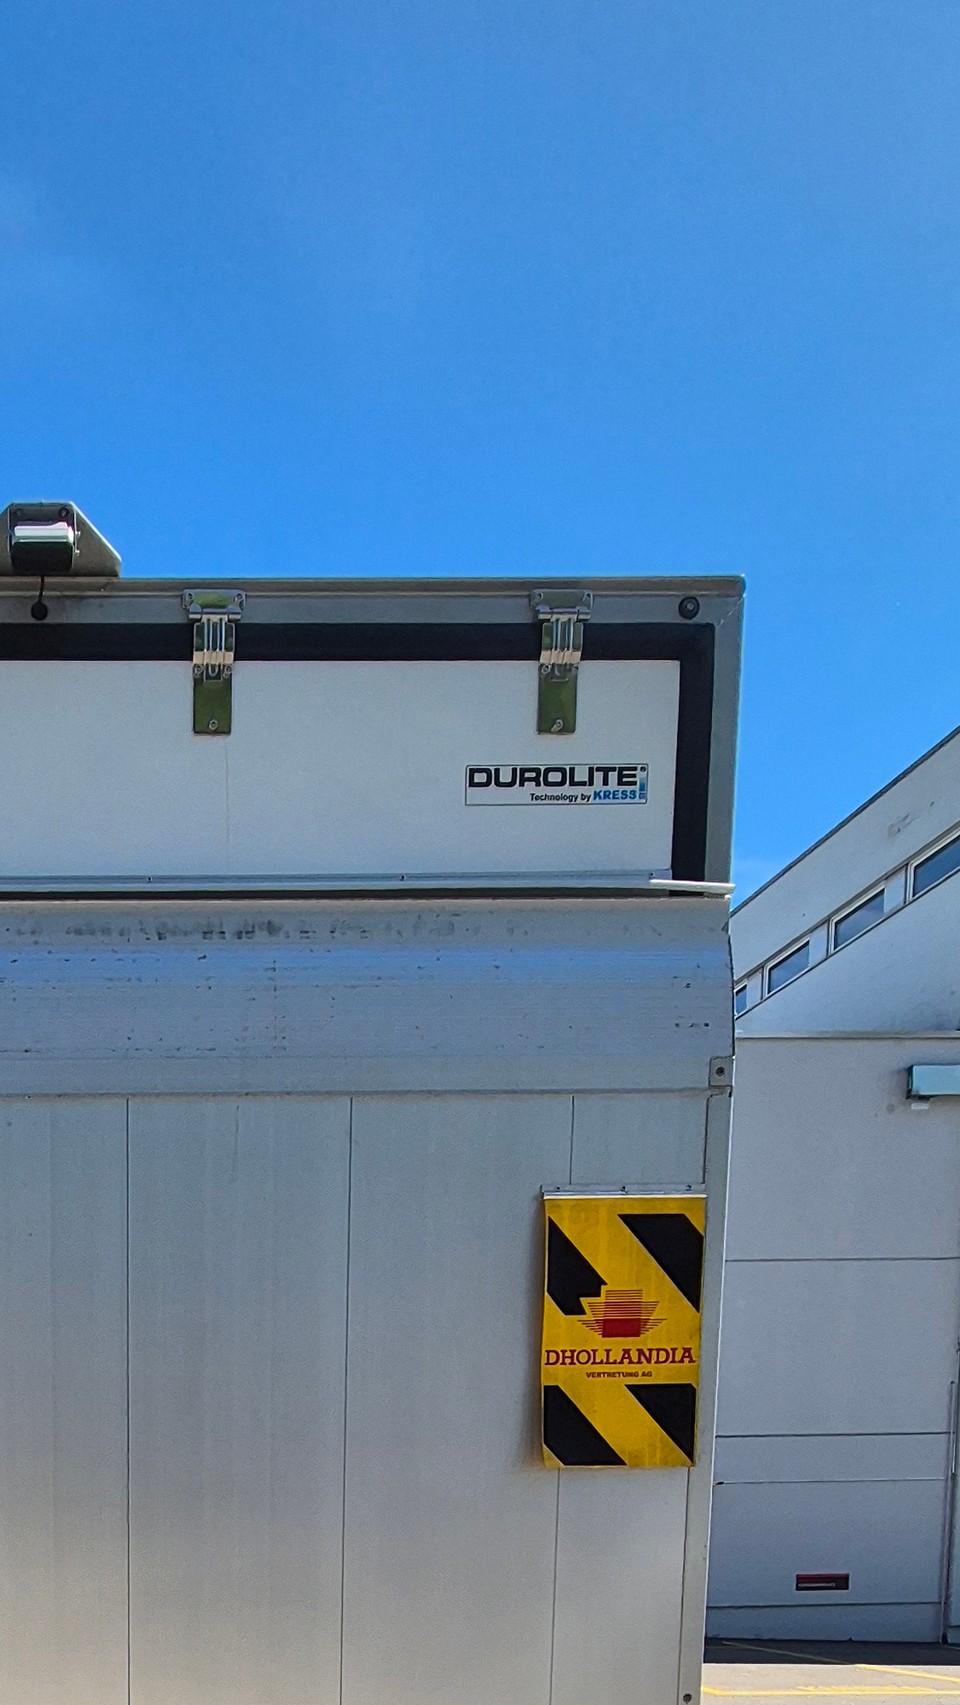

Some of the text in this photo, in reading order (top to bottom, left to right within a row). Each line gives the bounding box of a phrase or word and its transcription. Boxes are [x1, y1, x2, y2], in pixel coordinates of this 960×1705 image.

[530, 789, 637, 802] Technology by KRESS
[544, 1347, 696, 1366] DHOLLANDIA
